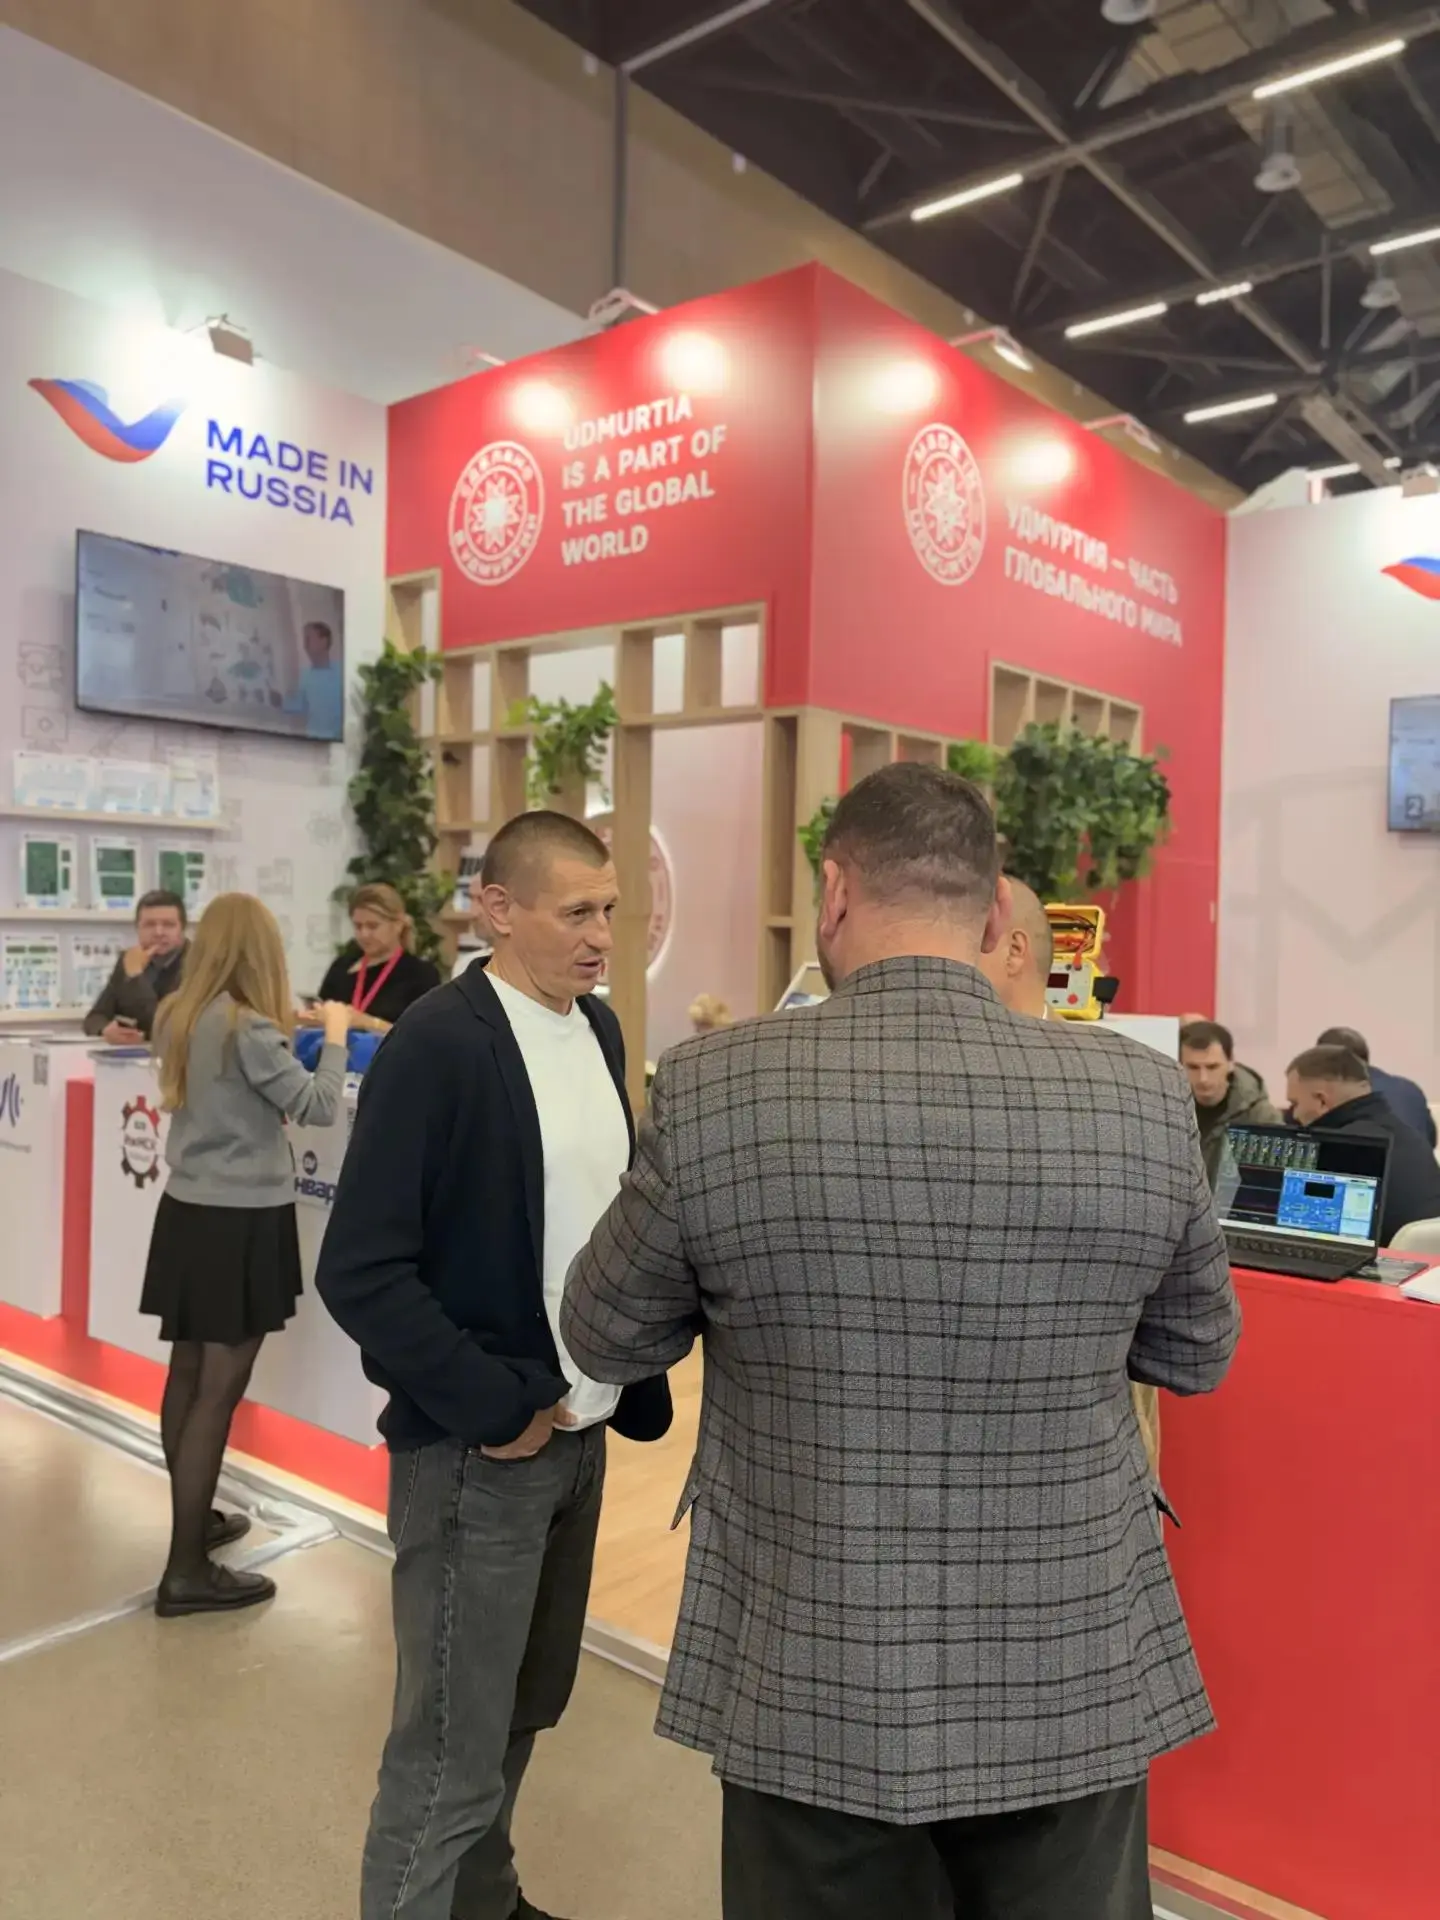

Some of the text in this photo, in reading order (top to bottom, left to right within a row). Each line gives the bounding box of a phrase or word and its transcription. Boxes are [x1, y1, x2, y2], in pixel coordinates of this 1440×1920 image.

[563, 393, 693, 451] UDMURTIA
[207, 419, 373, 495] MADE IN
[562, 424, 727, 490] IS A PART OF
[206, 459, 354, 527] RUSSIA
[561, 470, 716, 529] THE GLOBAL
[561, 525, 649, 567] WORLD
[1003, 499, 1108, 573] УДМУРТИЯ
[1004, 545, 1138, 629] ГЛОБАЛЬНОГО
